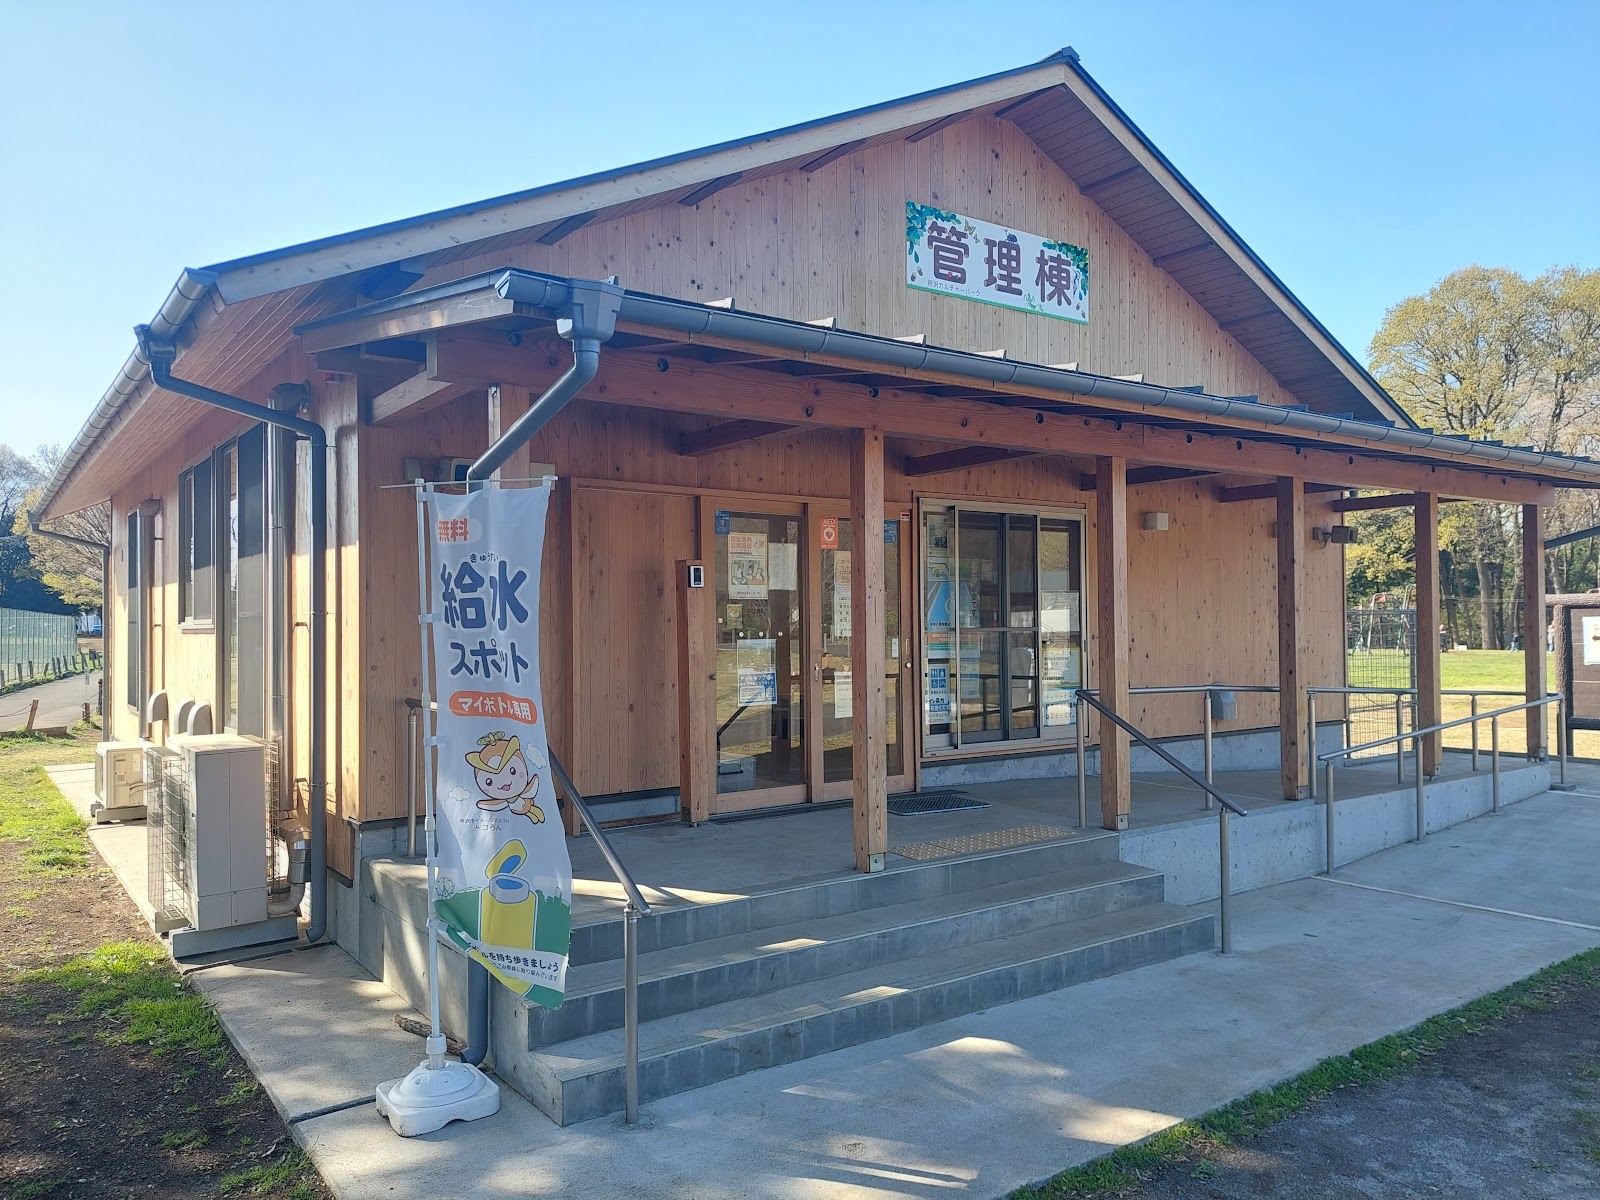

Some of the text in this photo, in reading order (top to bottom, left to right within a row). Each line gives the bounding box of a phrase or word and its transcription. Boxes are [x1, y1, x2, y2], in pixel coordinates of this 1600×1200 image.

[927, 221, 1071, 306] 管理棟
[927, 279, 981, 297] 所沢カルチャーパーク
[438, 517, 469, 542] 無料
[440, 560, 529, 631] 給水
[450, 638, 529, 683] スポット
[457, 696, 532, 720] マイボトル専用
